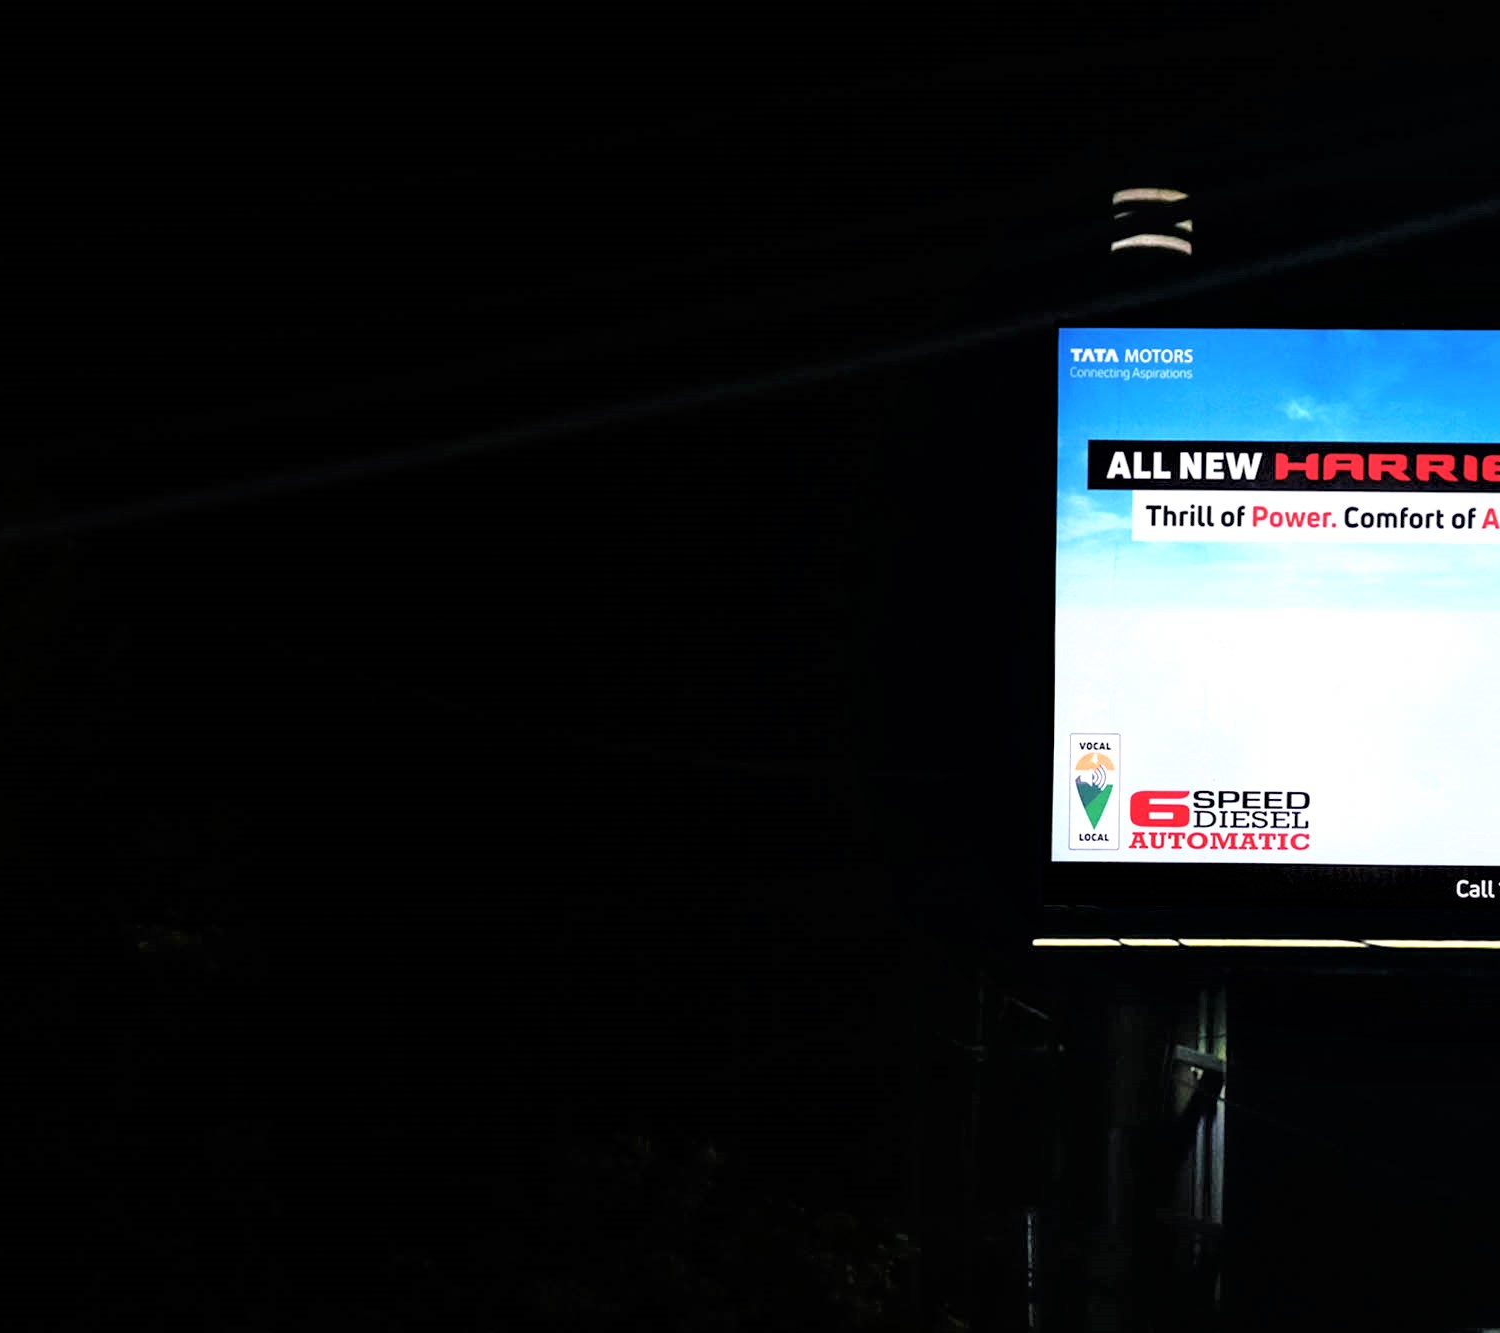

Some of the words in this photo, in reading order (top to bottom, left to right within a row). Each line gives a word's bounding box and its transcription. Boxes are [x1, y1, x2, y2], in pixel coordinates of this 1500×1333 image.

[1070, 348, 1119, 363] TATA
[1124, 348, 1194, 364] MOTORS
[1069, 366, 1130, 381] Connecting
[1132, 367, 1193, 380] Aspirations
[1106, 451, 1172, 480] ALL
[1179, 452, 1263, 481] NEW
[1146, 504, 1215, 528] Thrill
[1220, 505, 1246, 528] of
[1251, 505, 1337, 529] Power.
[1344, 506, 1445, 529] Comfort
[1451, 507, 1477, 530] of
[1079, 742, 1112, 751] VOCAL
[1129, 790, 1190, 828] 6
[1193, 790, 1311, 810] SPEED
[1193, 810, 1310, 829] DIESEL
[1079, 833, 1110, 842] LOCAL
[1129, 832, 1311, 851] AUTOMATIC
[1456, 879, 1495, 899] Call
